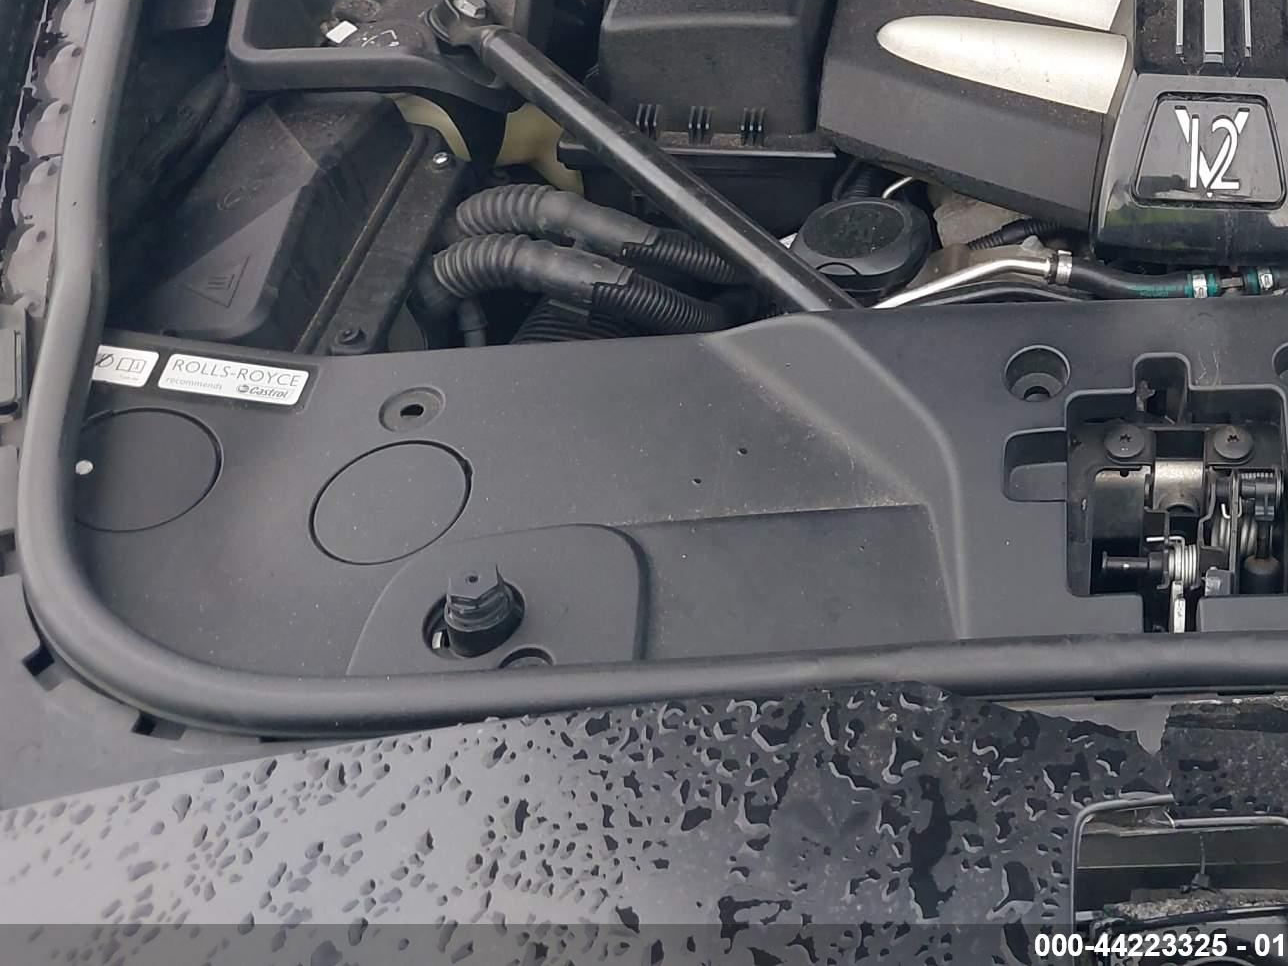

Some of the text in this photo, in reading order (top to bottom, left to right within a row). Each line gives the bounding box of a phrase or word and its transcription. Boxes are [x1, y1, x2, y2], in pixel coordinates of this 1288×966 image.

[172, 359, 300, 387] ROLLS-ROYCE
[165, 377, 223, 390] recommends
[249, 386, 289, 398] Castrol
